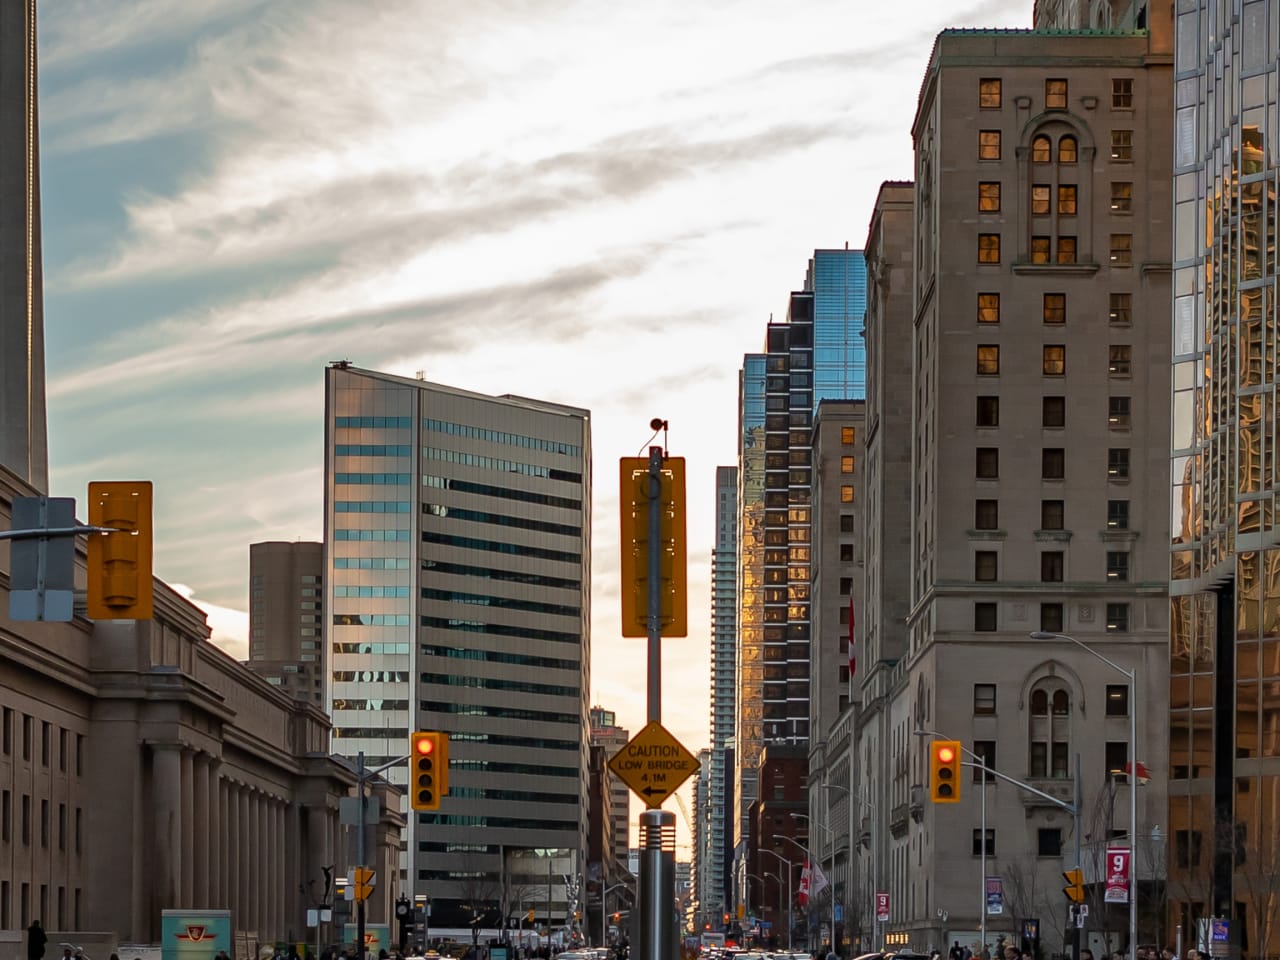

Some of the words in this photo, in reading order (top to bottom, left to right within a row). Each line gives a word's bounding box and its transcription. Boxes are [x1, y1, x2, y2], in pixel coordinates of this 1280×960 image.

[628, 745, 680, 757] CAUTION
[618, 760, 642, 770] LOW
[647, 760, 688, 770] BRIDGE
[1113, 855, 1124, 872] 9
[880, 896, 887, 906] 9
